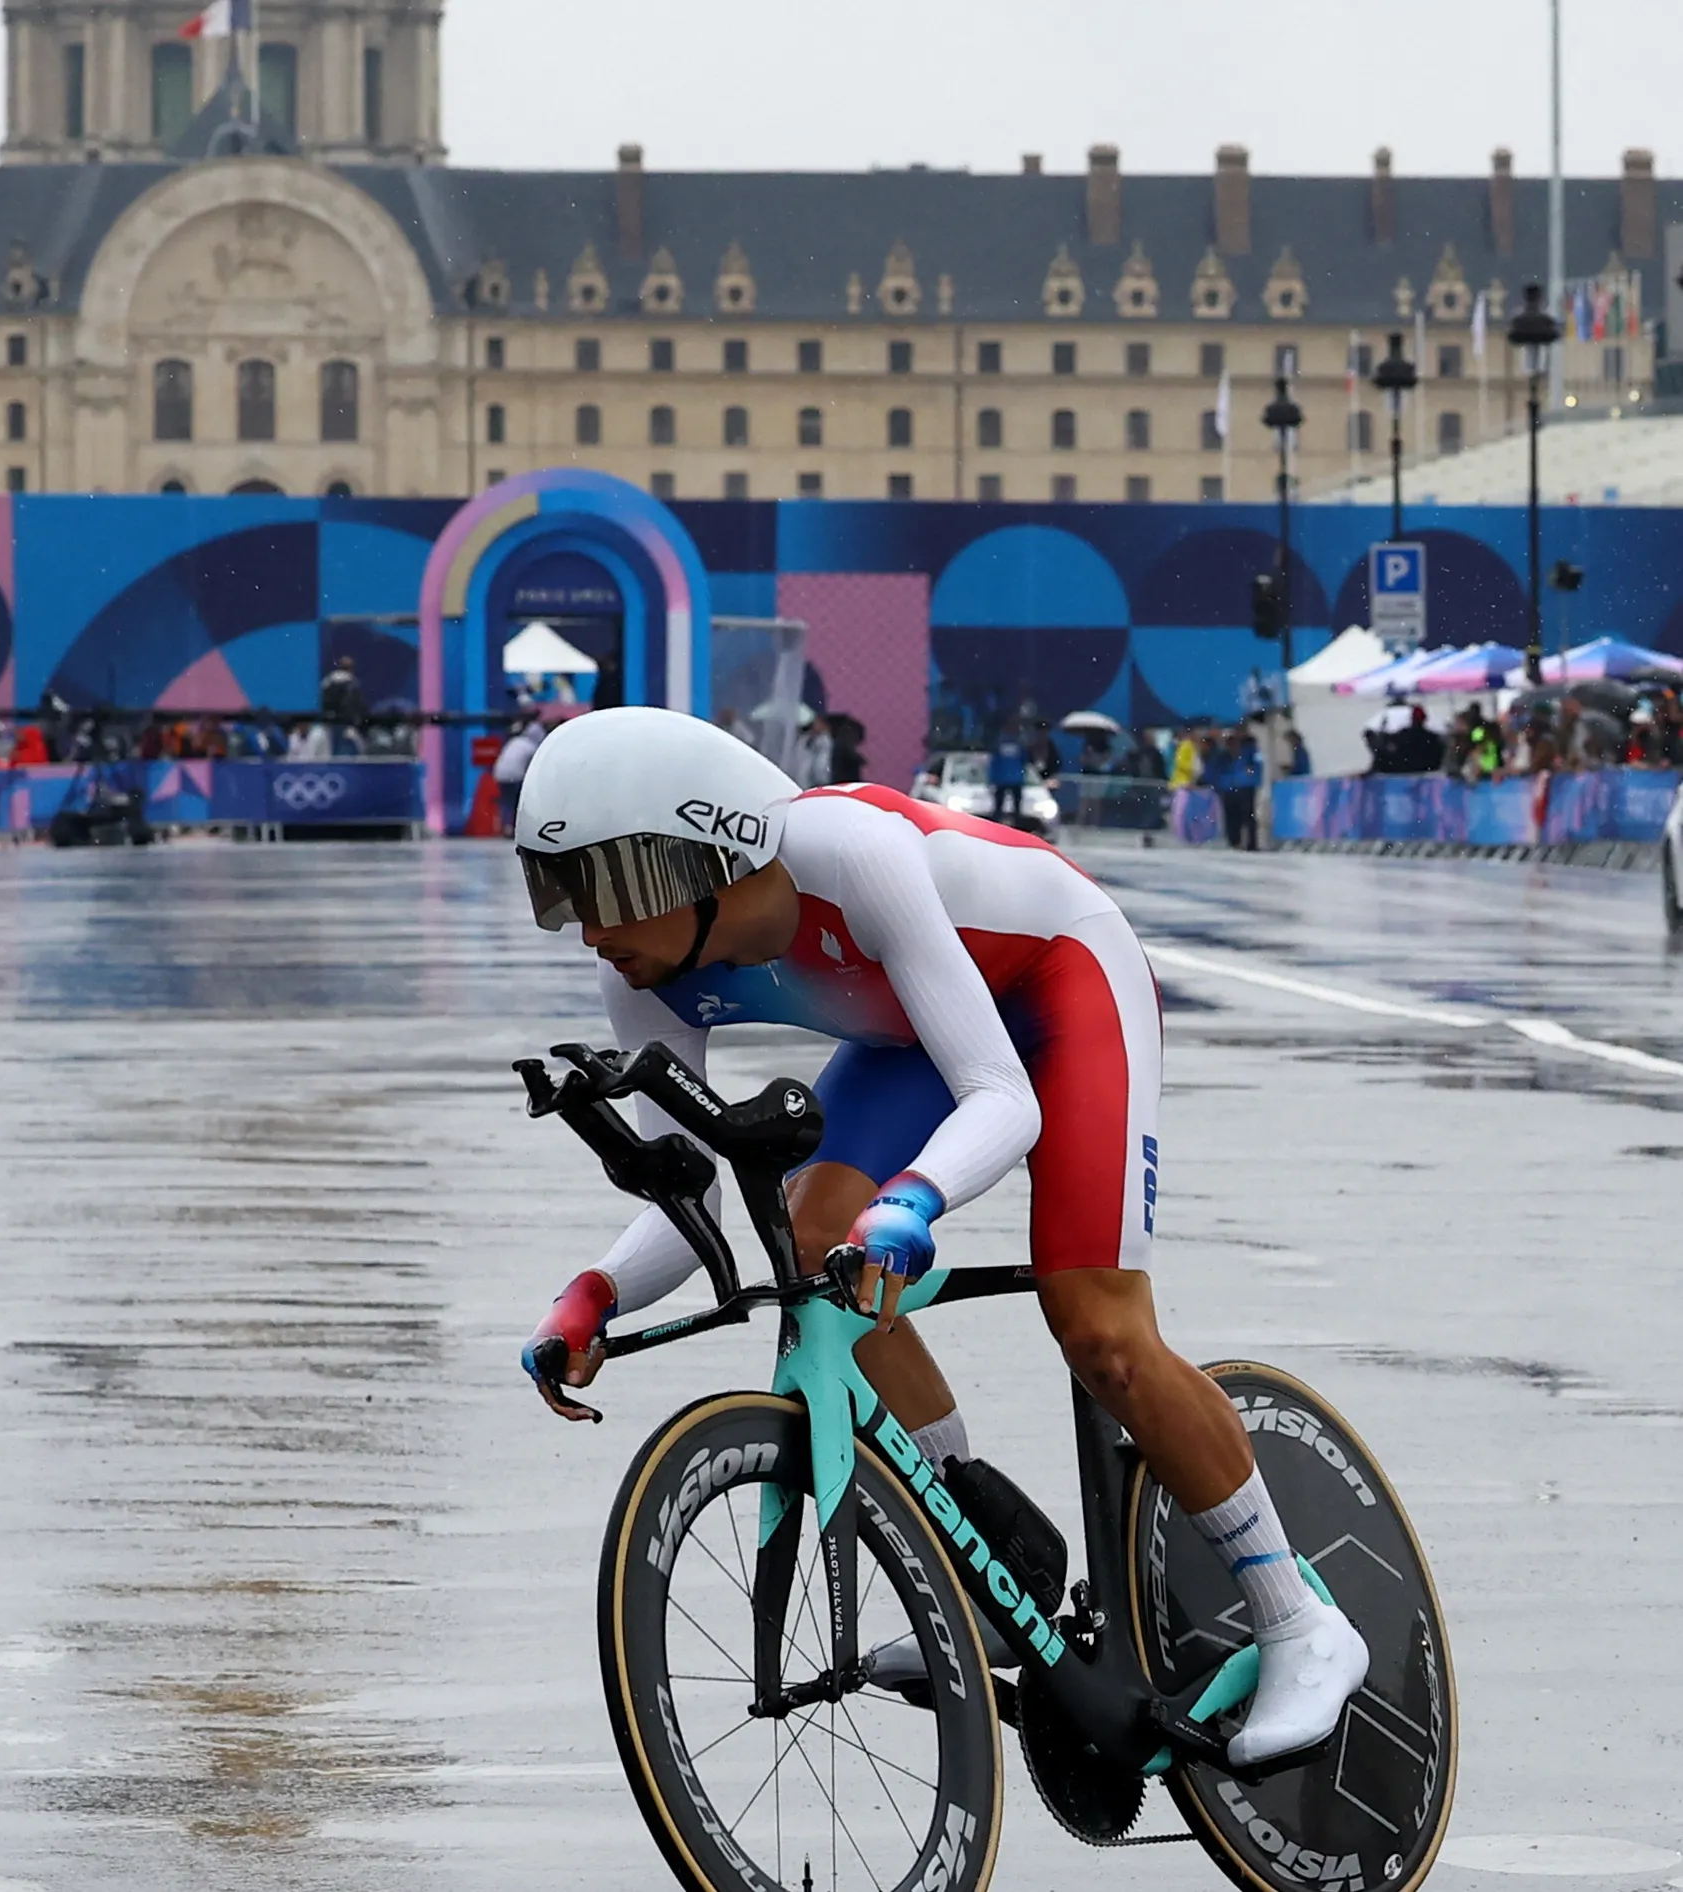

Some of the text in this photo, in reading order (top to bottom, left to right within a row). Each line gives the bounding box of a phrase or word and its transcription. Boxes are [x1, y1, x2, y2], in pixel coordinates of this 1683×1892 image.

[874, 1413, 1067, 1668] Bianchi
[1223, 1512, 1260, 1542] SPORTIF
[828, 1536, 839, 1577] CORSE
